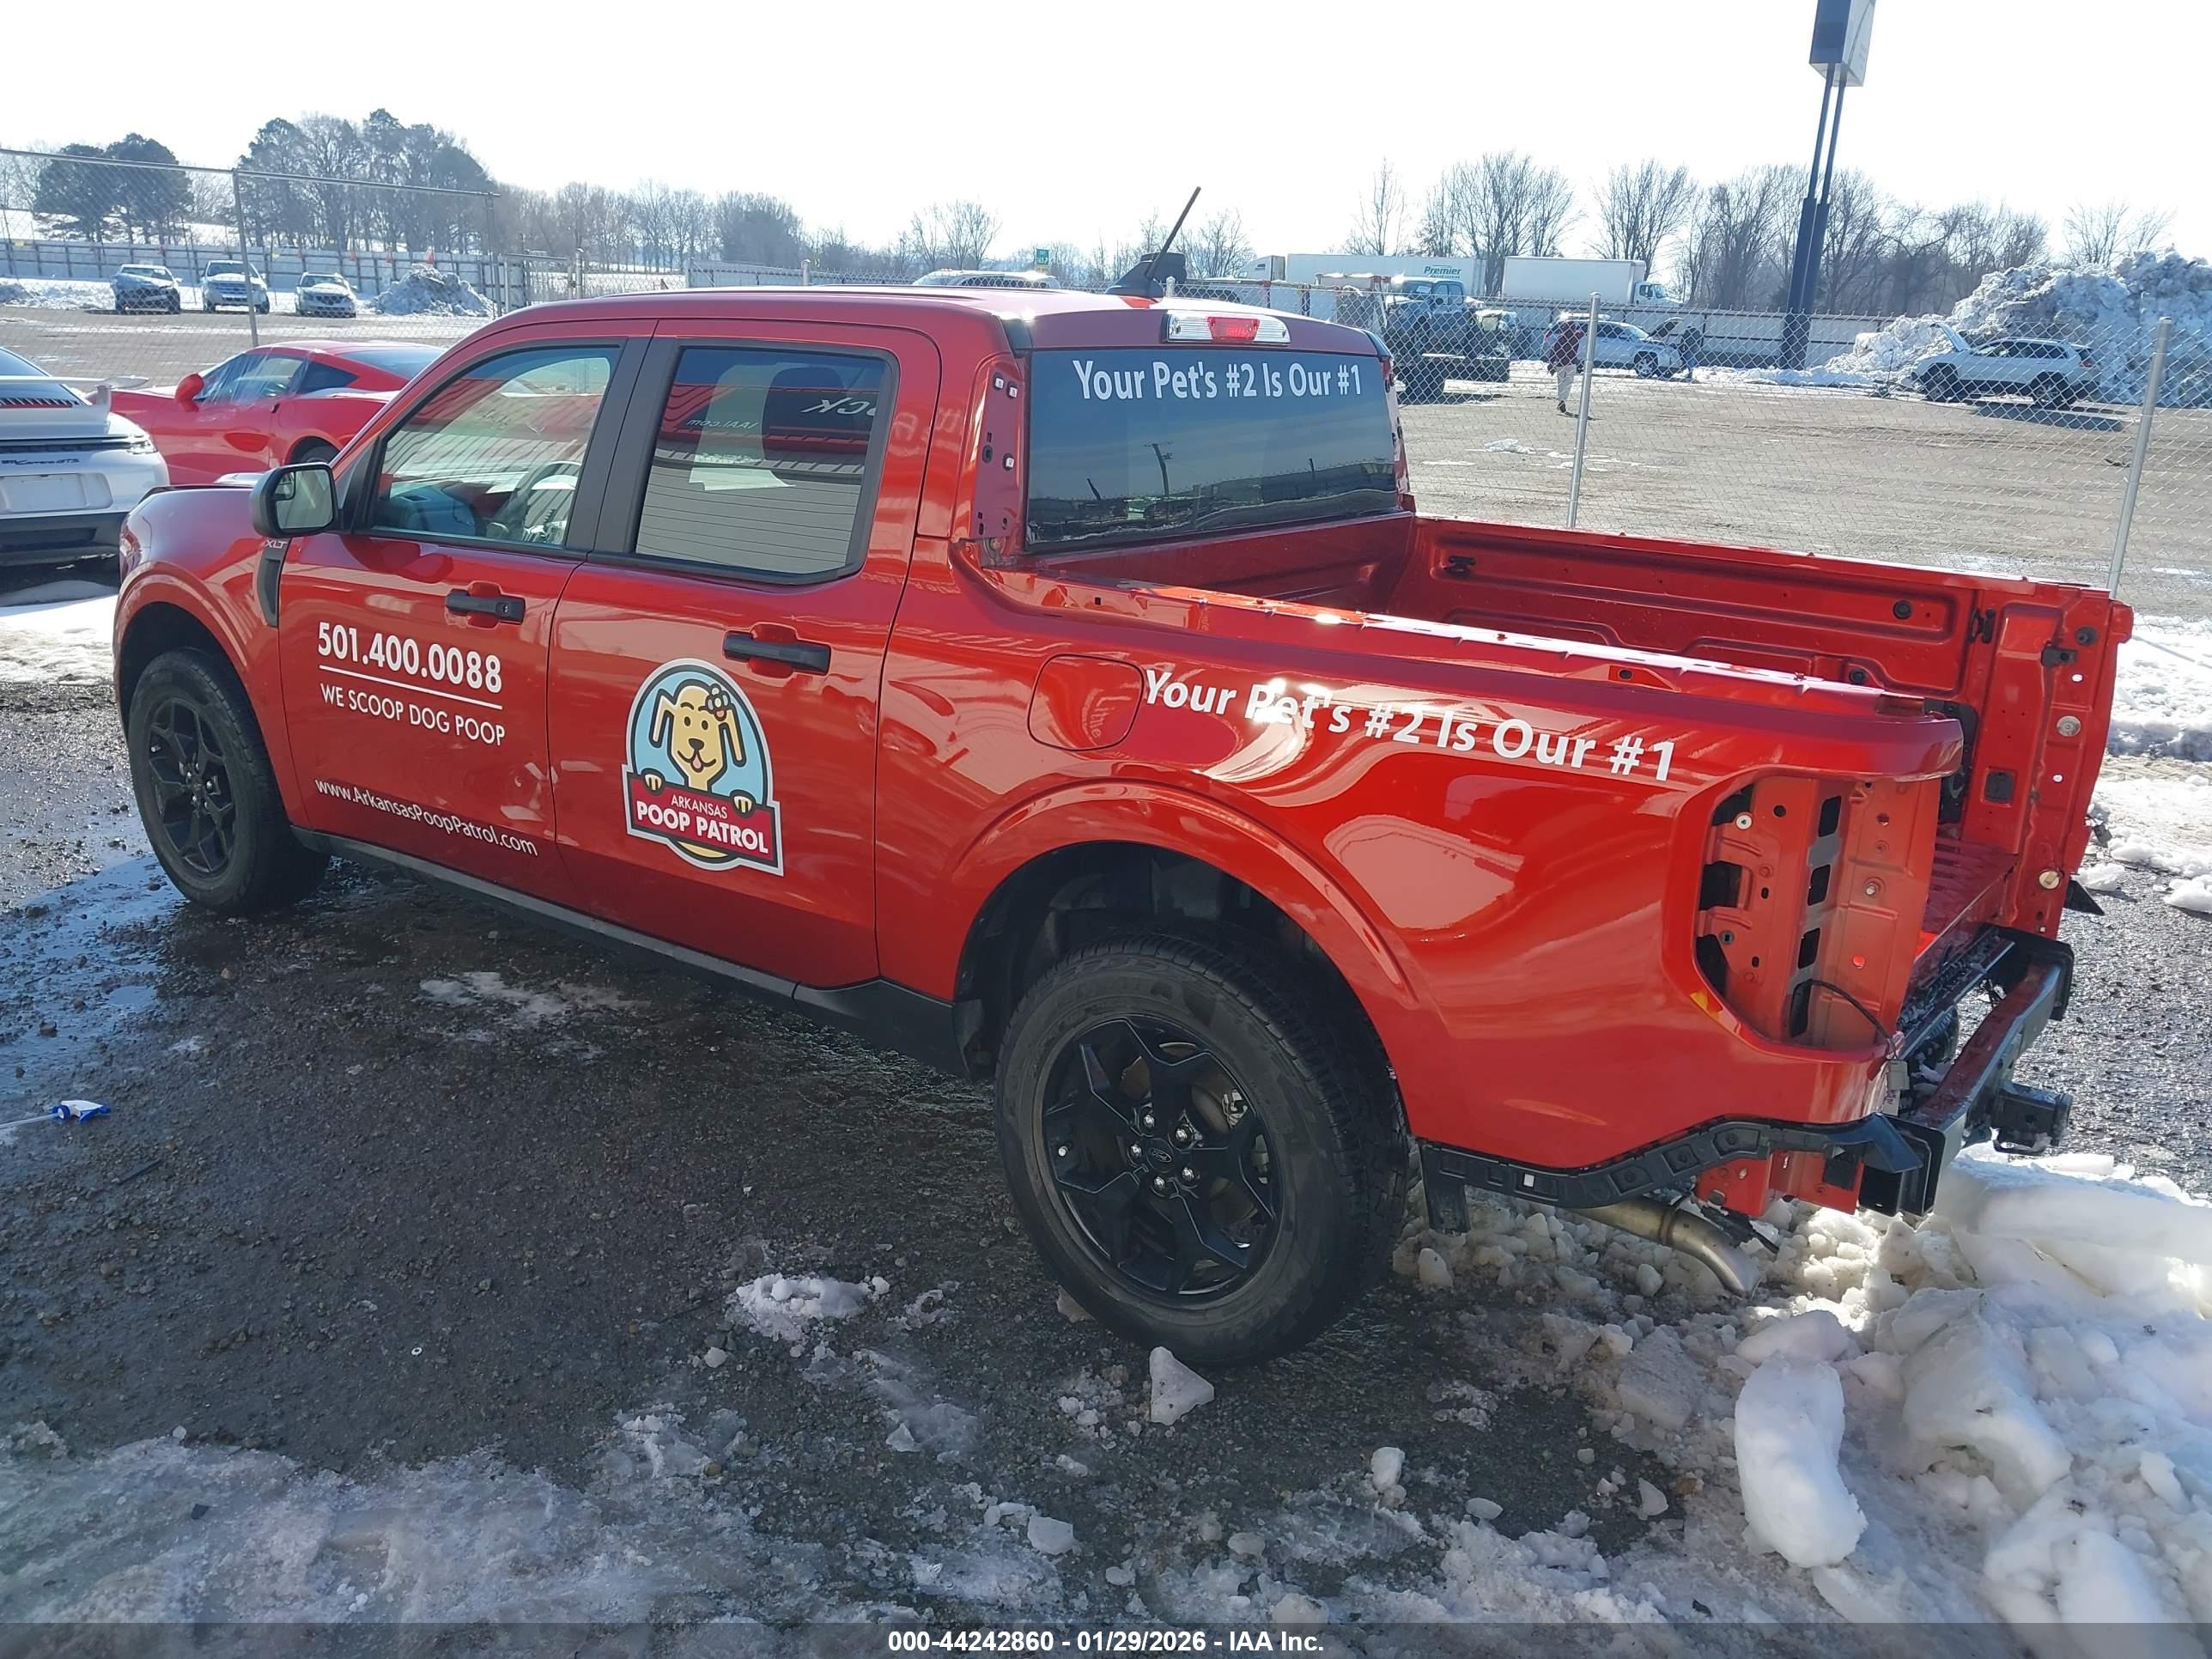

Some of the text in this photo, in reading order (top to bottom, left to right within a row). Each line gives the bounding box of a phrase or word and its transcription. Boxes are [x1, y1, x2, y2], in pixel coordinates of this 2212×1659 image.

[1424, 265, 1462, 276] Premier
[1073, 360, 1361, 400] Your Pet's #2 Is Our #1
[263, 538, 288, 549] XLT
[318, 622, 503, 694] 501.400.0088
[320, 683, 507, 746] WE SCOOP DOG POOP
[1145, 669, 1676, 782] Your Pet's #2 Is Our #1
[315, 778, 538, 857] www.ArkansasPoopPatrol.com
[636, 800, 769, 855] POOP PATROL
[671, 793, 728, 820] ARKANSAS
